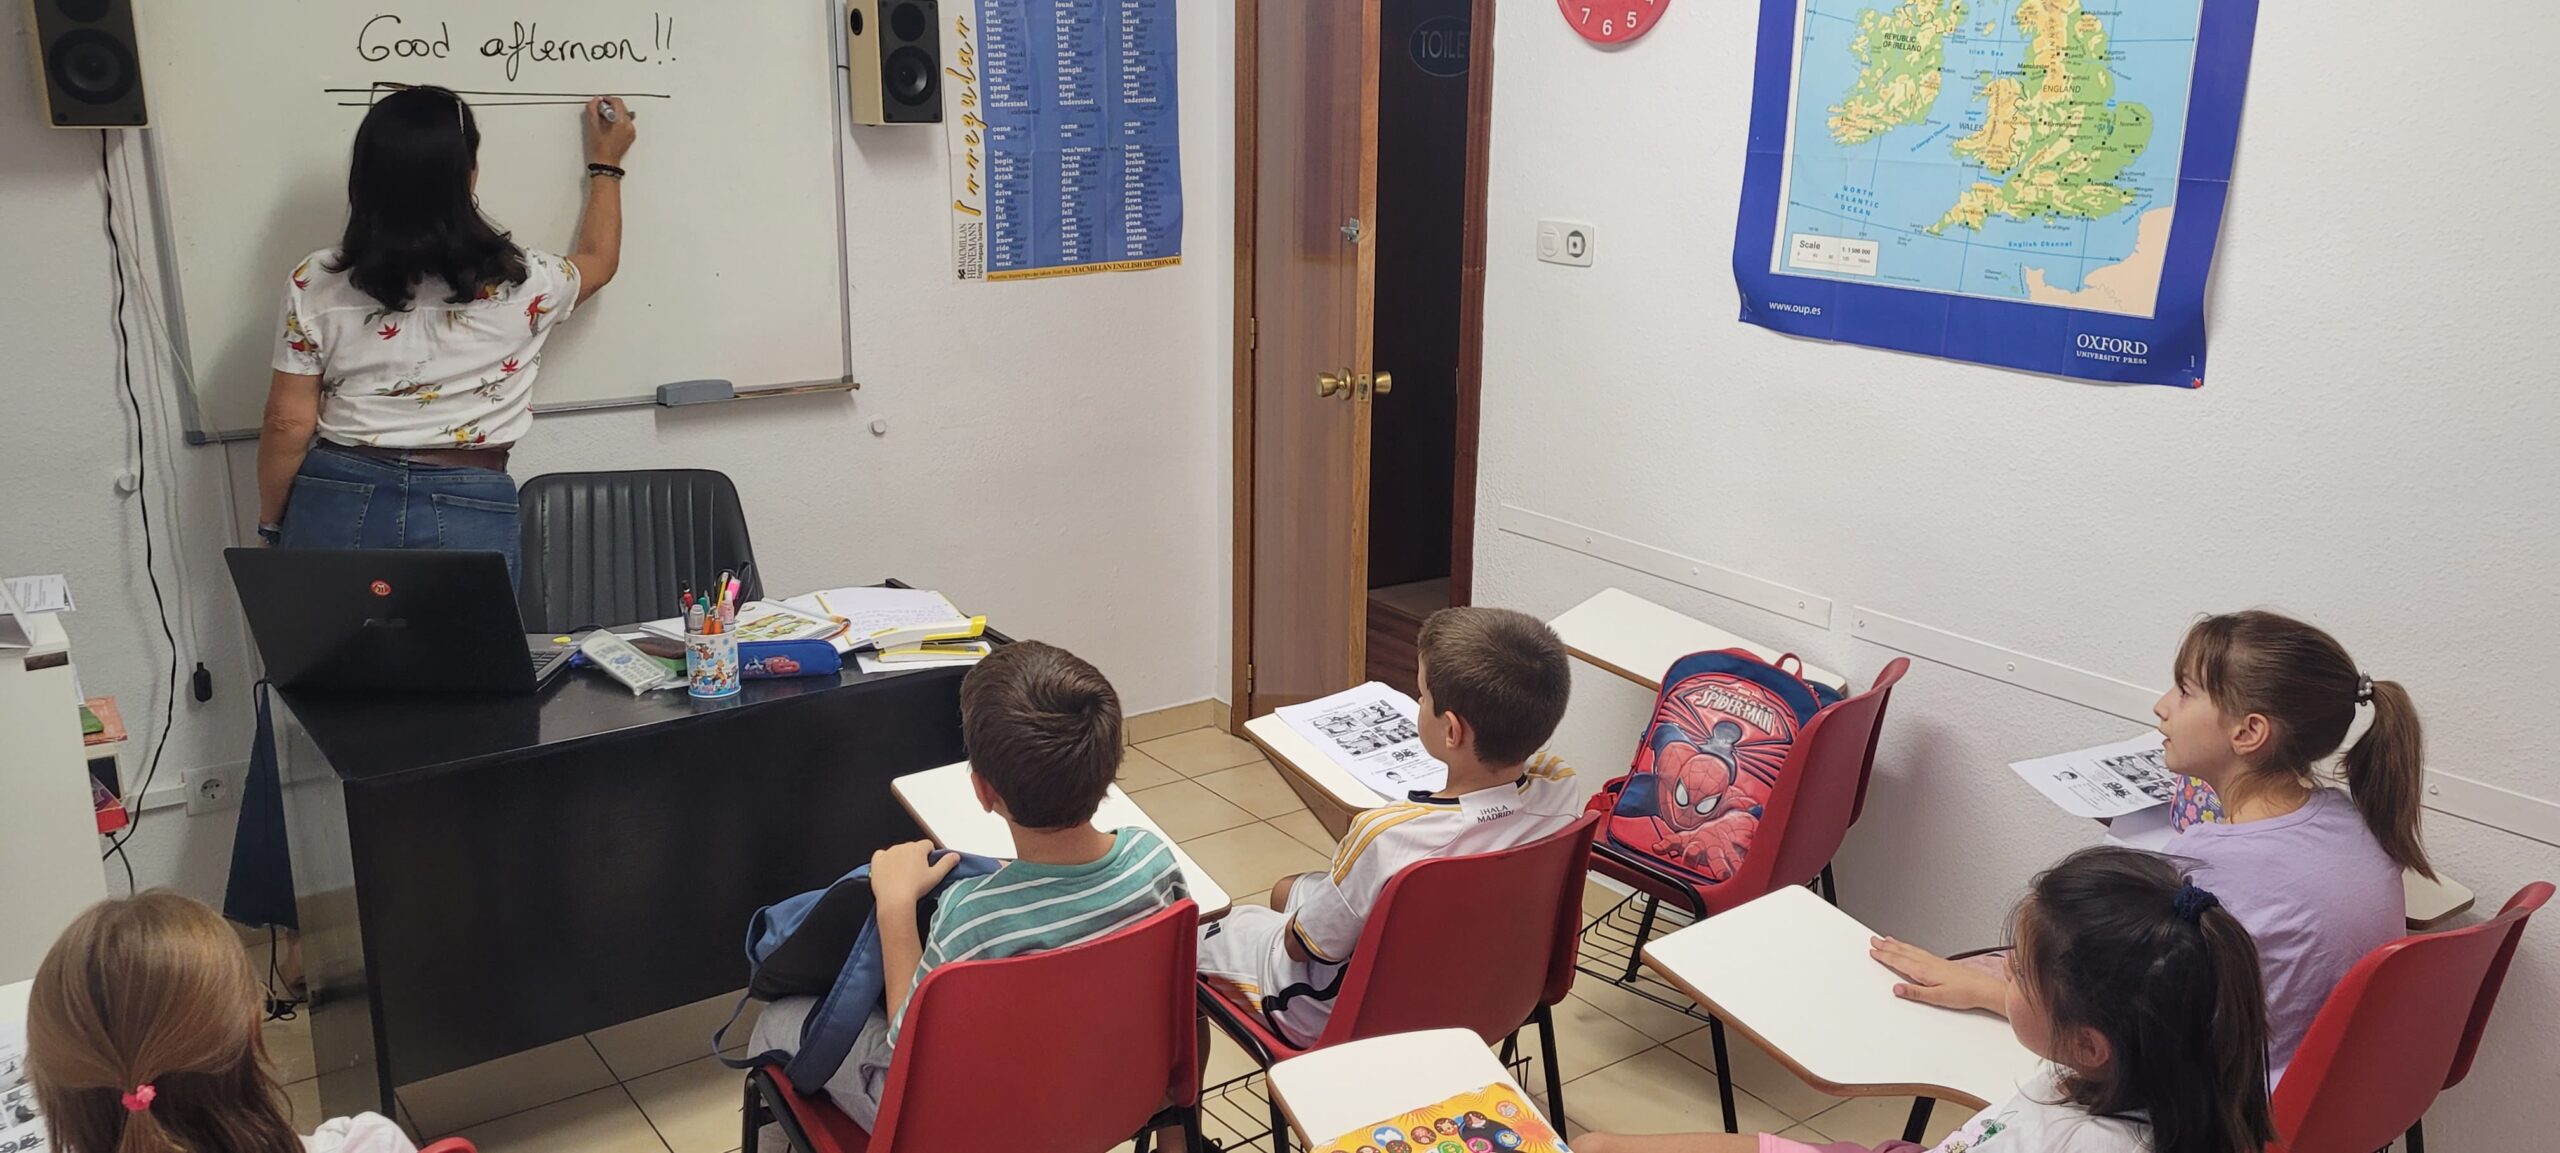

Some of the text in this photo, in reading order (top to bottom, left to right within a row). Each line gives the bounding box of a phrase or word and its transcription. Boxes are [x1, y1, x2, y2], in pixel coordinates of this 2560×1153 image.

[1582, 8, 1590, 24] 7
[1626, 12, 1636, 28] 5
[1602, 19, 1612, 36] 6
[1421, 30, 1465, 58] TOILE
[1884, 33, 1917, 43] REPUBLIC
[357, 12, 676, 82] Good afternoon!!
[1883, 40, 1922, 52] OF IRELAND
[2042, 85, 2081, 93] ENGLAND
[944, 16, 988, 217] Irregular
[1960, 122, 1984, 131] WALES
[1843, 185, 1874, 197] NORTH
[1834, 193, 1880, 208] ATLANTIC
[1840, 204, 1871, 216] OCEAN
[958, 224, 967, 268] MACMILLAN
[967, 223, 976, 279] HEINEMANN
[1800, 240, 1821, 250] Scale
[1072, 264, 1113, 273] MACMILLAN
[1113, 262, 1142, 270] ENGLISH
[1143, 258, 1181, 268] DICTIONARY
[1768, 301, 1821, 316] www.oup.es
[2077, 334, 2148, 355] OXFORD
[2076, 350, 2147, 364] UNIVERSITY PRESS
